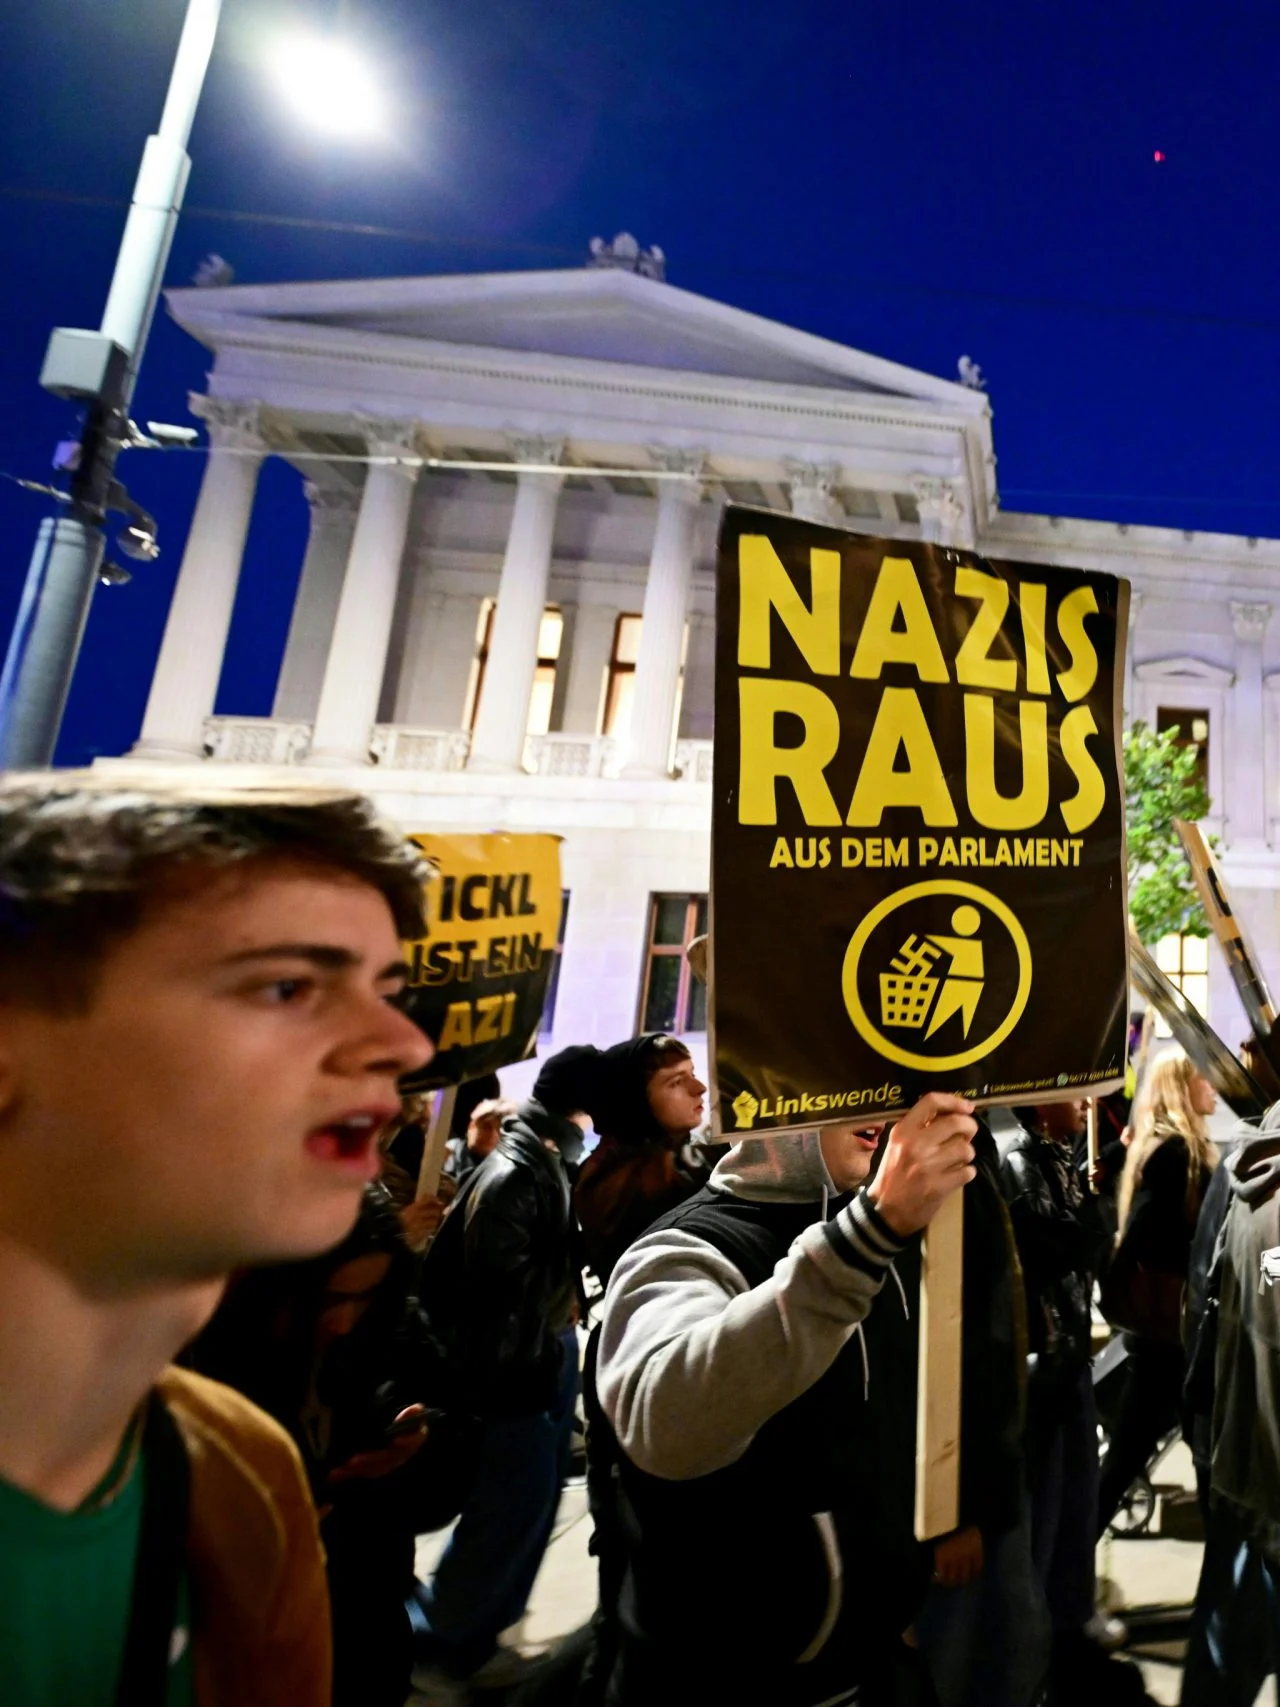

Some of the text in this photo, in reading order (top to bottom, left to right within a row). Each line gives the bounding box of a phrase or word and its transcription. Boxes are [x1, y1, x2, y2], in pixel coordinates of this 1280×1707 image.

[737, 534, 1099, 703] NAZIS
[738, 677, 1106, 835] RAUS
[769, 836, 1084, 869] AUS DEM PARLAMENT
[438, 872, 537, 922] ICKL
[405, 931, 543, 988] IST EIN
[437, 991, 517, 1052] AZI
[758, 1081, 903, 1118] Linkswende
